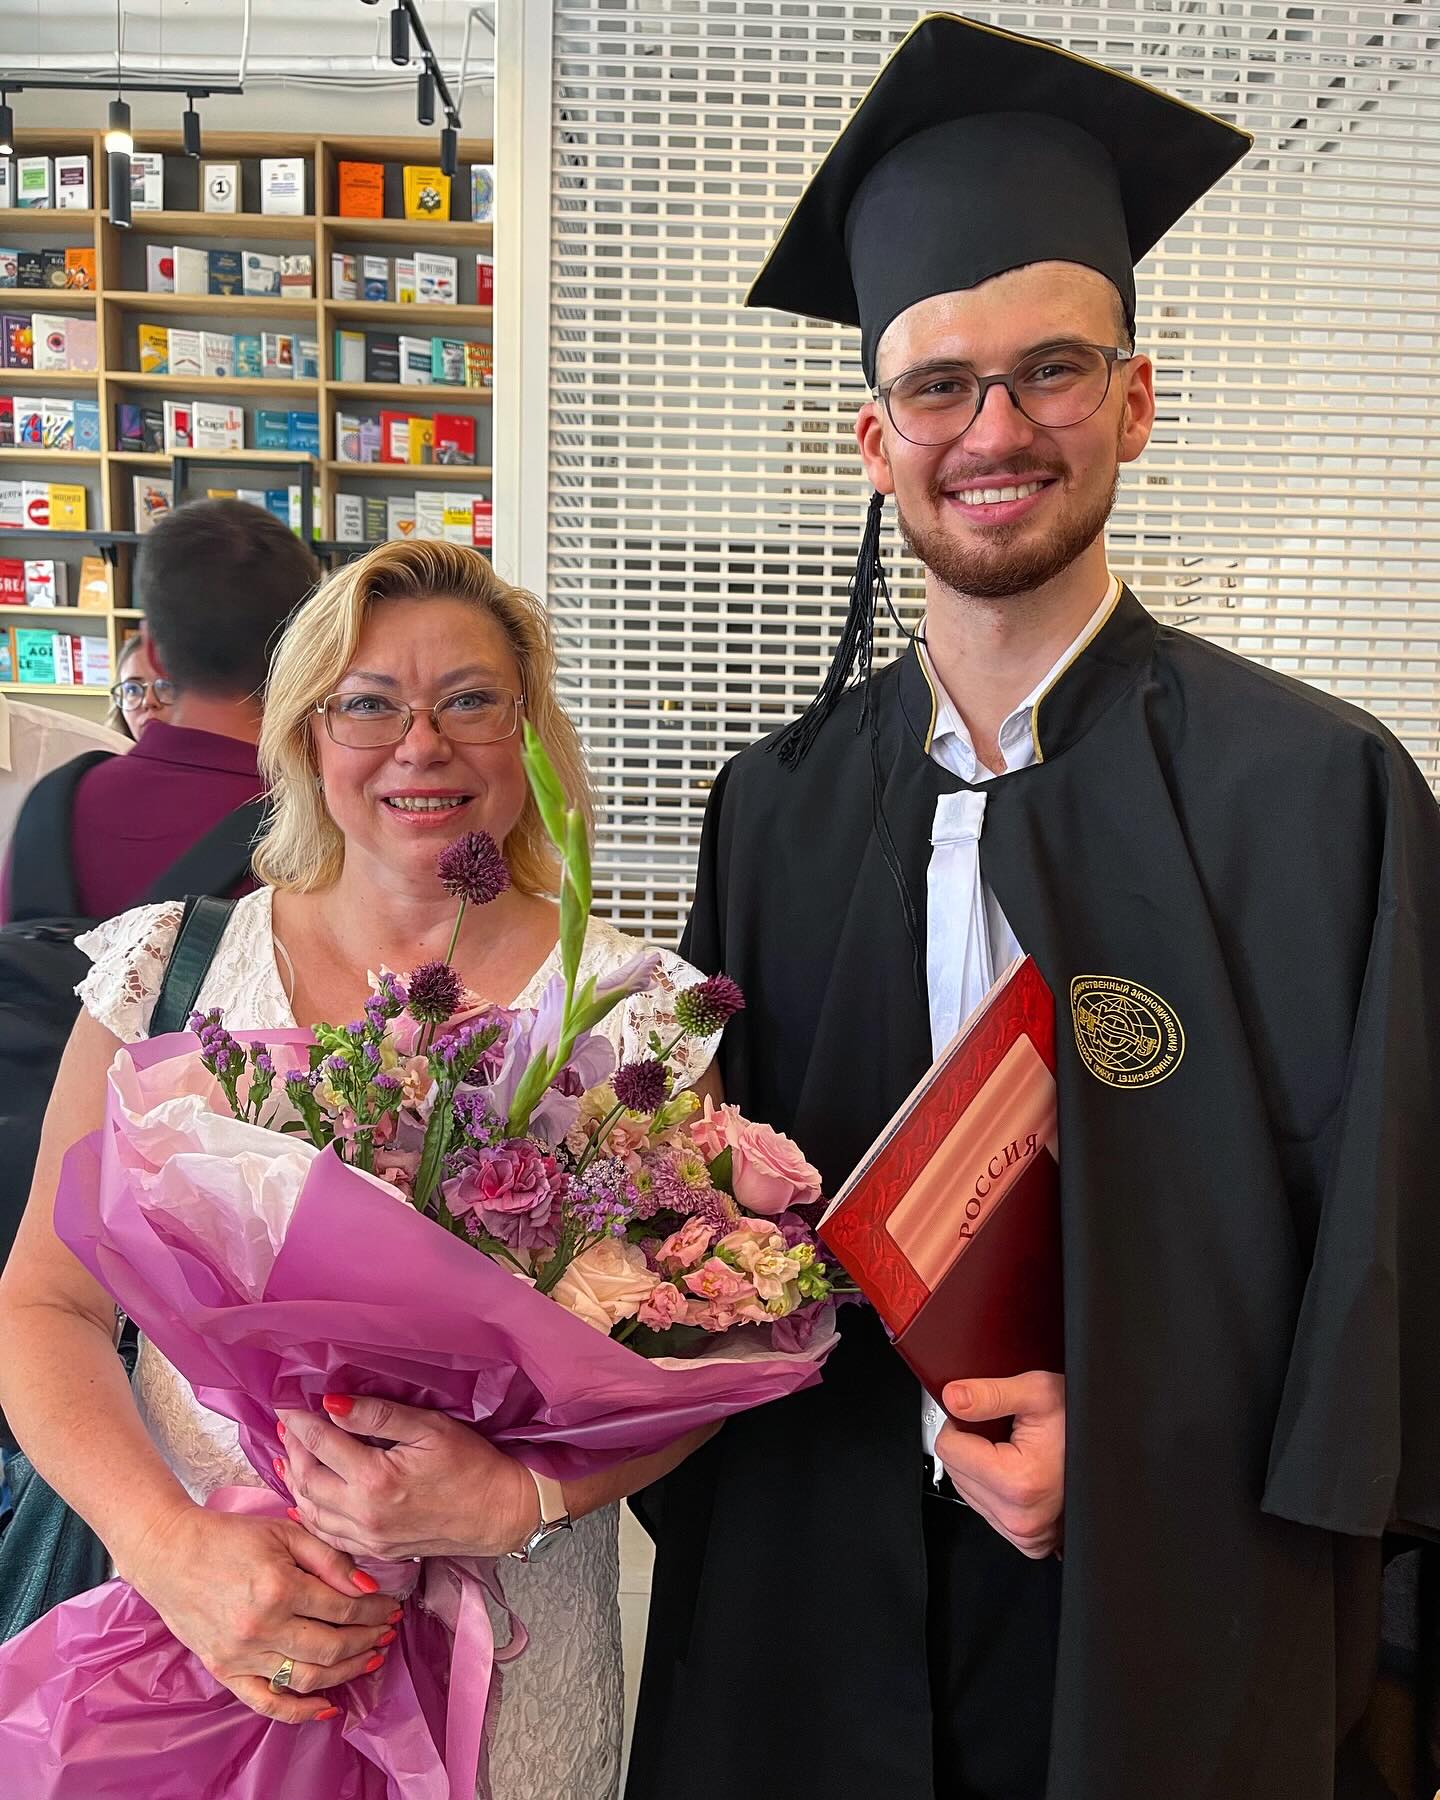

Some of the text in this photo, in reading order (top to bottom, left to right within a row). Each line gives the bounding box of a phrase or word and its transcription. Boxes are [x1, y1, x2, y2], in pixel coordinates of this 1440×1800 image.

[215, 181, 225, 193] 1
[1130, 989, 1178, 1052] ЭКОНОМИЧЕСКИЙ
[1117, 1053, 1174, 1083] УНИВЕРСИТЕТ
[959, 1133, 1038, 1240] РОССИЯ
